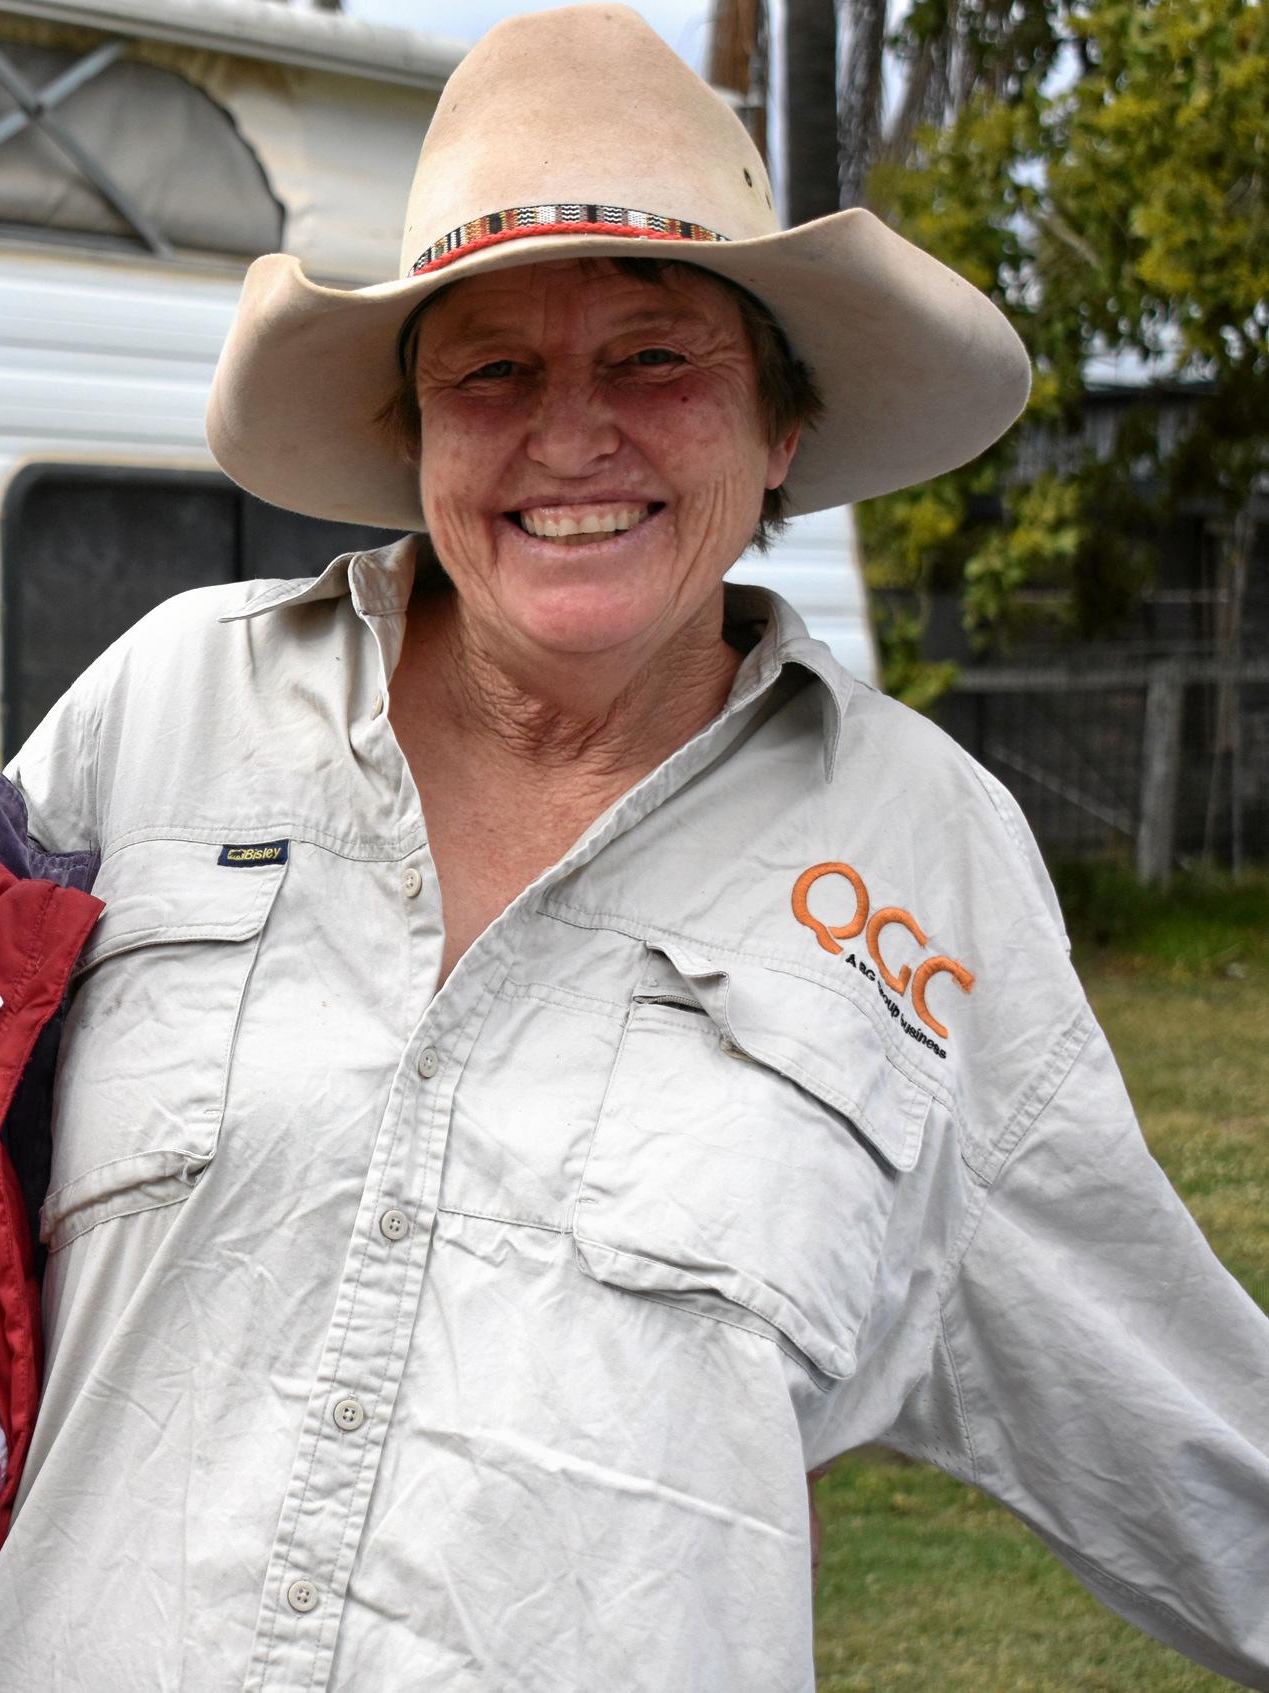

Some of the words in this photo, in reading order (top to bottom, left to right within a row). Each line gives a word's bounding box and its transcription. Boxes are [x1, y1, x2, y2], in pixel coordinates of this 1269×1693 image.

[243, 848, 281, 860] Bisley
[792, 862, 975, 1039] QGC
[845, 954, 857, 968] A
